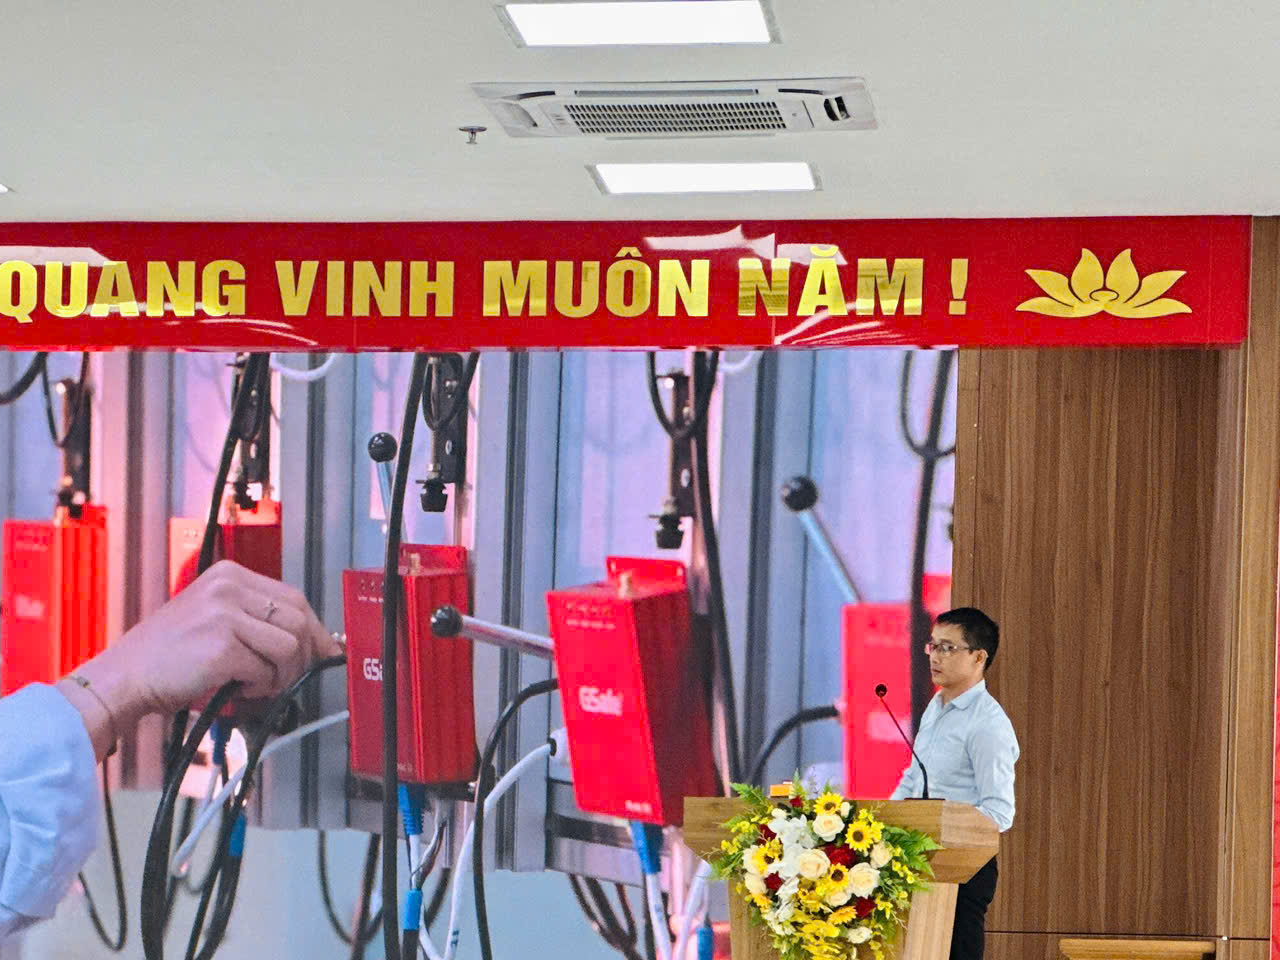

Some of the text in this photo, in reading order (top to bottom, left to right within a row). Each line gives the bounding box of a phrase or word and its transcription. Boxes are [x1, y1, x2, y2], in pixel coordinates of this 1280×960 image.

[275, 260, 454, 317] VINH
[482, 247, 709, 317] MUÔN
[738, 245, 923, 316] NĂM
[948, 258, 968, 315] !
